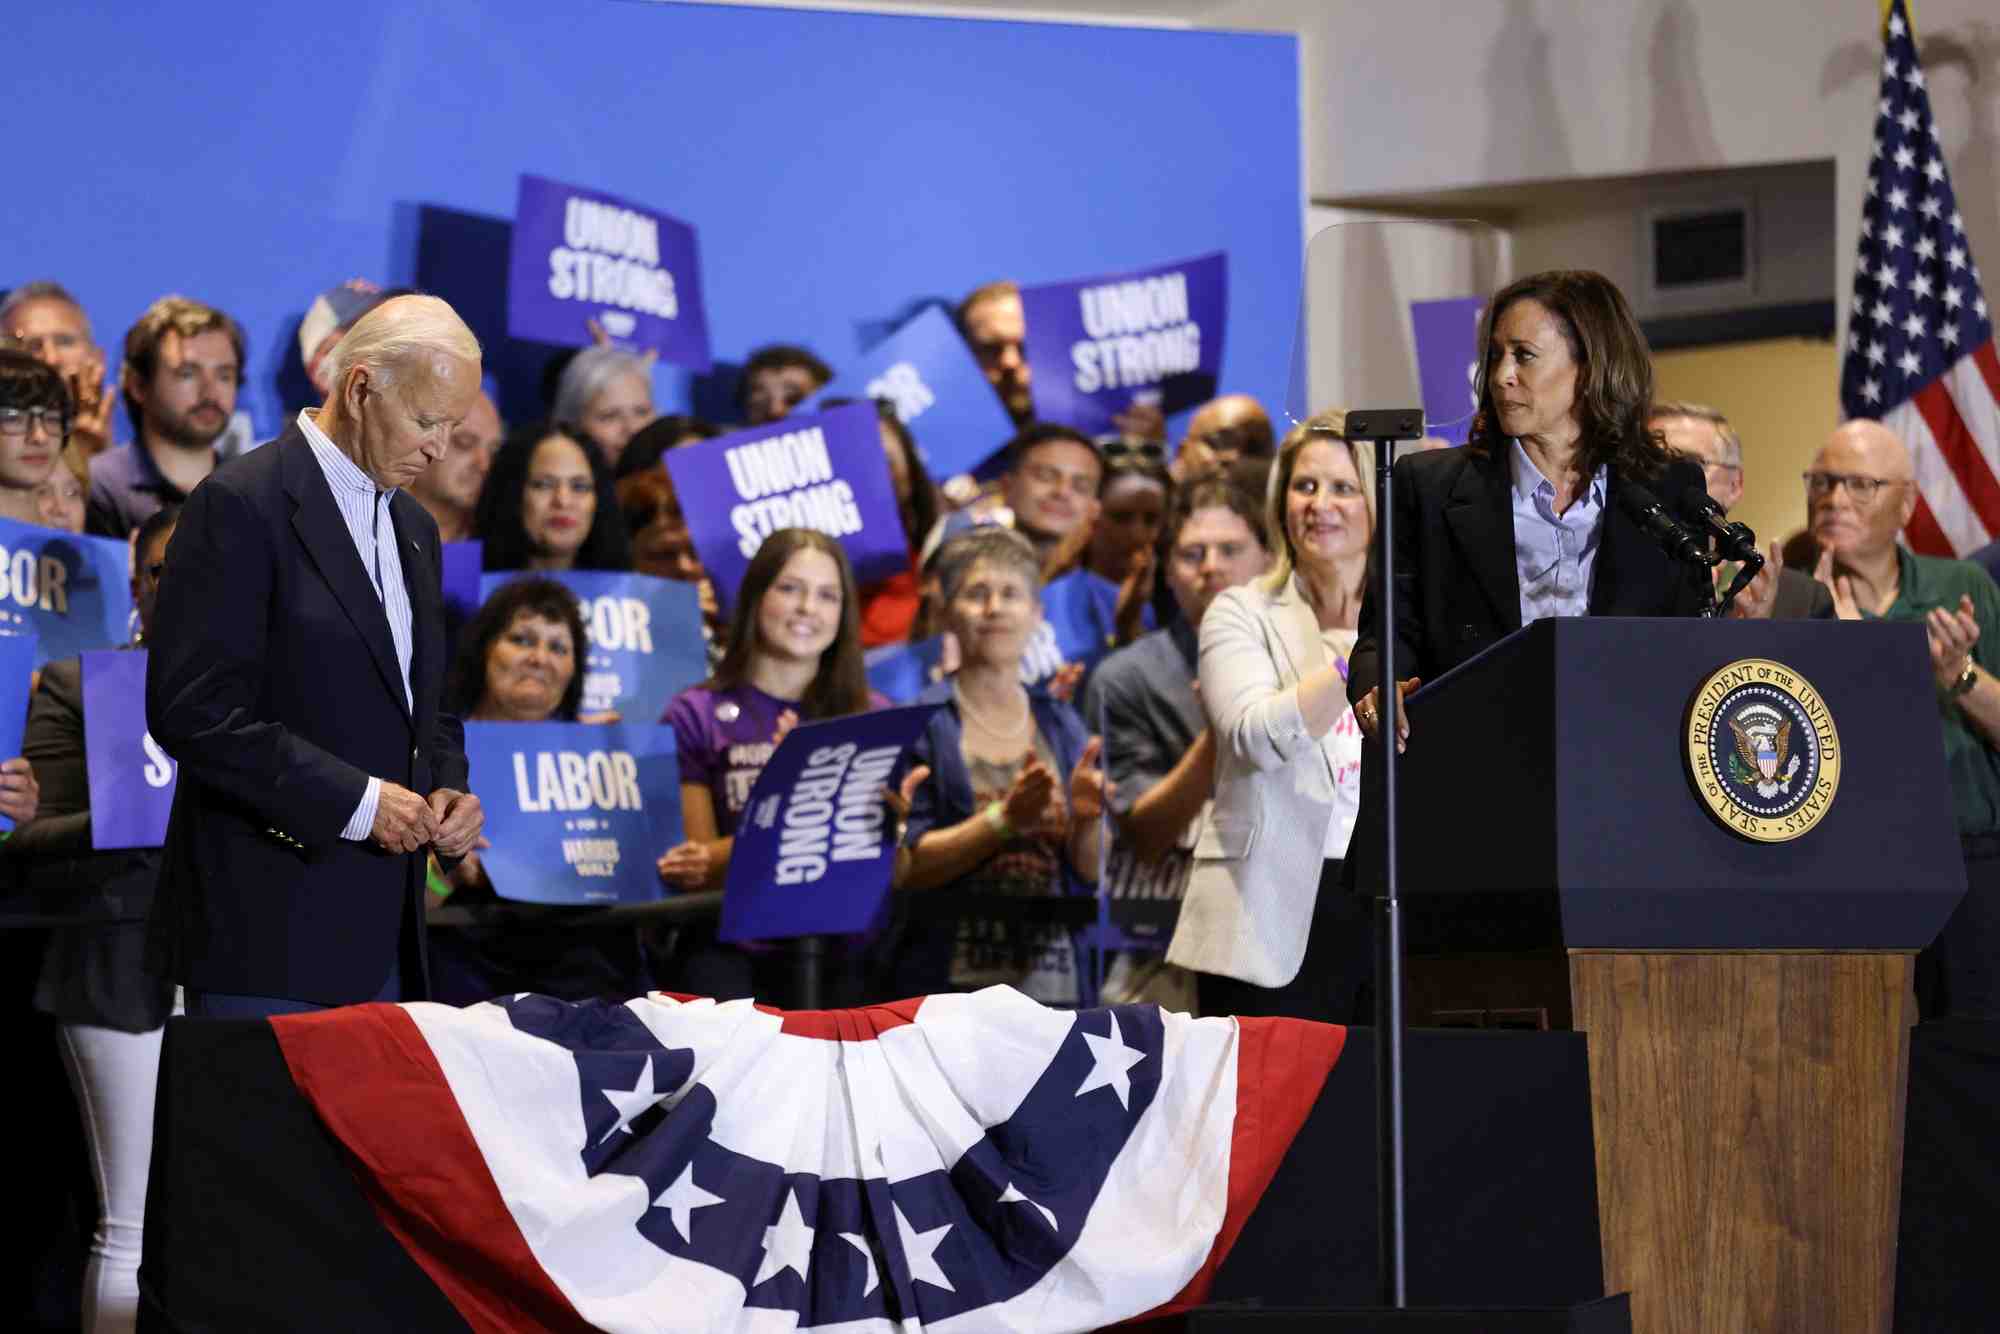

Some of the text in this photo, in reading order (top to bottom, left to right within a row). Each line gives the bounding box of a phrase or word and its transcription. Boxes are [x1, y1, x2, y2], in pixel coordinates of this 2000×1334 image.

[564, 196, 660, 270] UNION
[548, 245, 679, 321] STRONG
[1080, 271, 1189, 340] UNION
[1071, 321, 1201, 394] STRONG
[724, 425, 834, 501] UNION
[512, 750, 643, 813] LABOR
[1693, 665, 1836, 833] SEAL OF THE PRESIDENT OF THE UNITED STATES
[775, 741, 858, 886] STRONG
[830, 745, 902, 862] UNION
